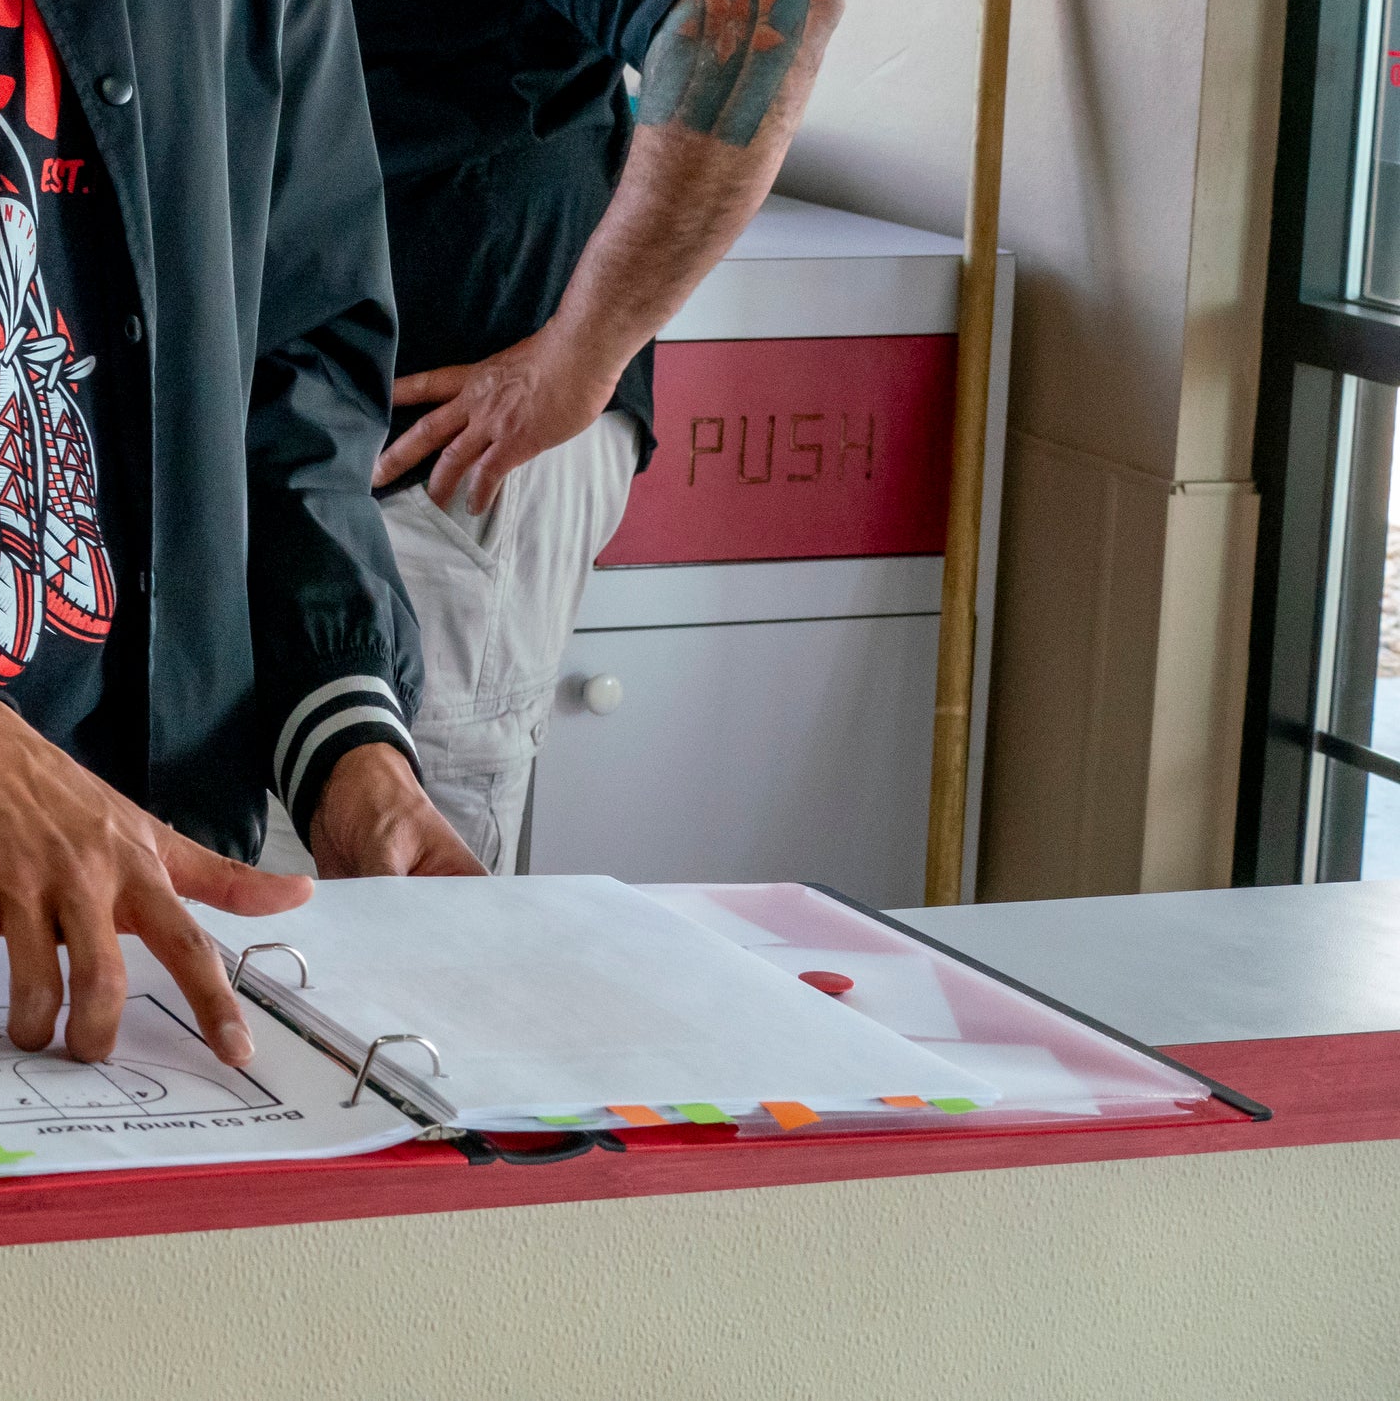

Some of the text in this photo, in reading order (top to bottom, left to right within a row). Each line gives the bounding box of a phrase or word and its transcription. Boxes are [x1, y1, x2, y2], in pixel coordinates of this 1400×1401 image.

[40, 157, 89, 194] EST.
[687, 412, 876, 487] PUSH
[36, 1109, 304, 1136] Box 53 Vandy Razor
